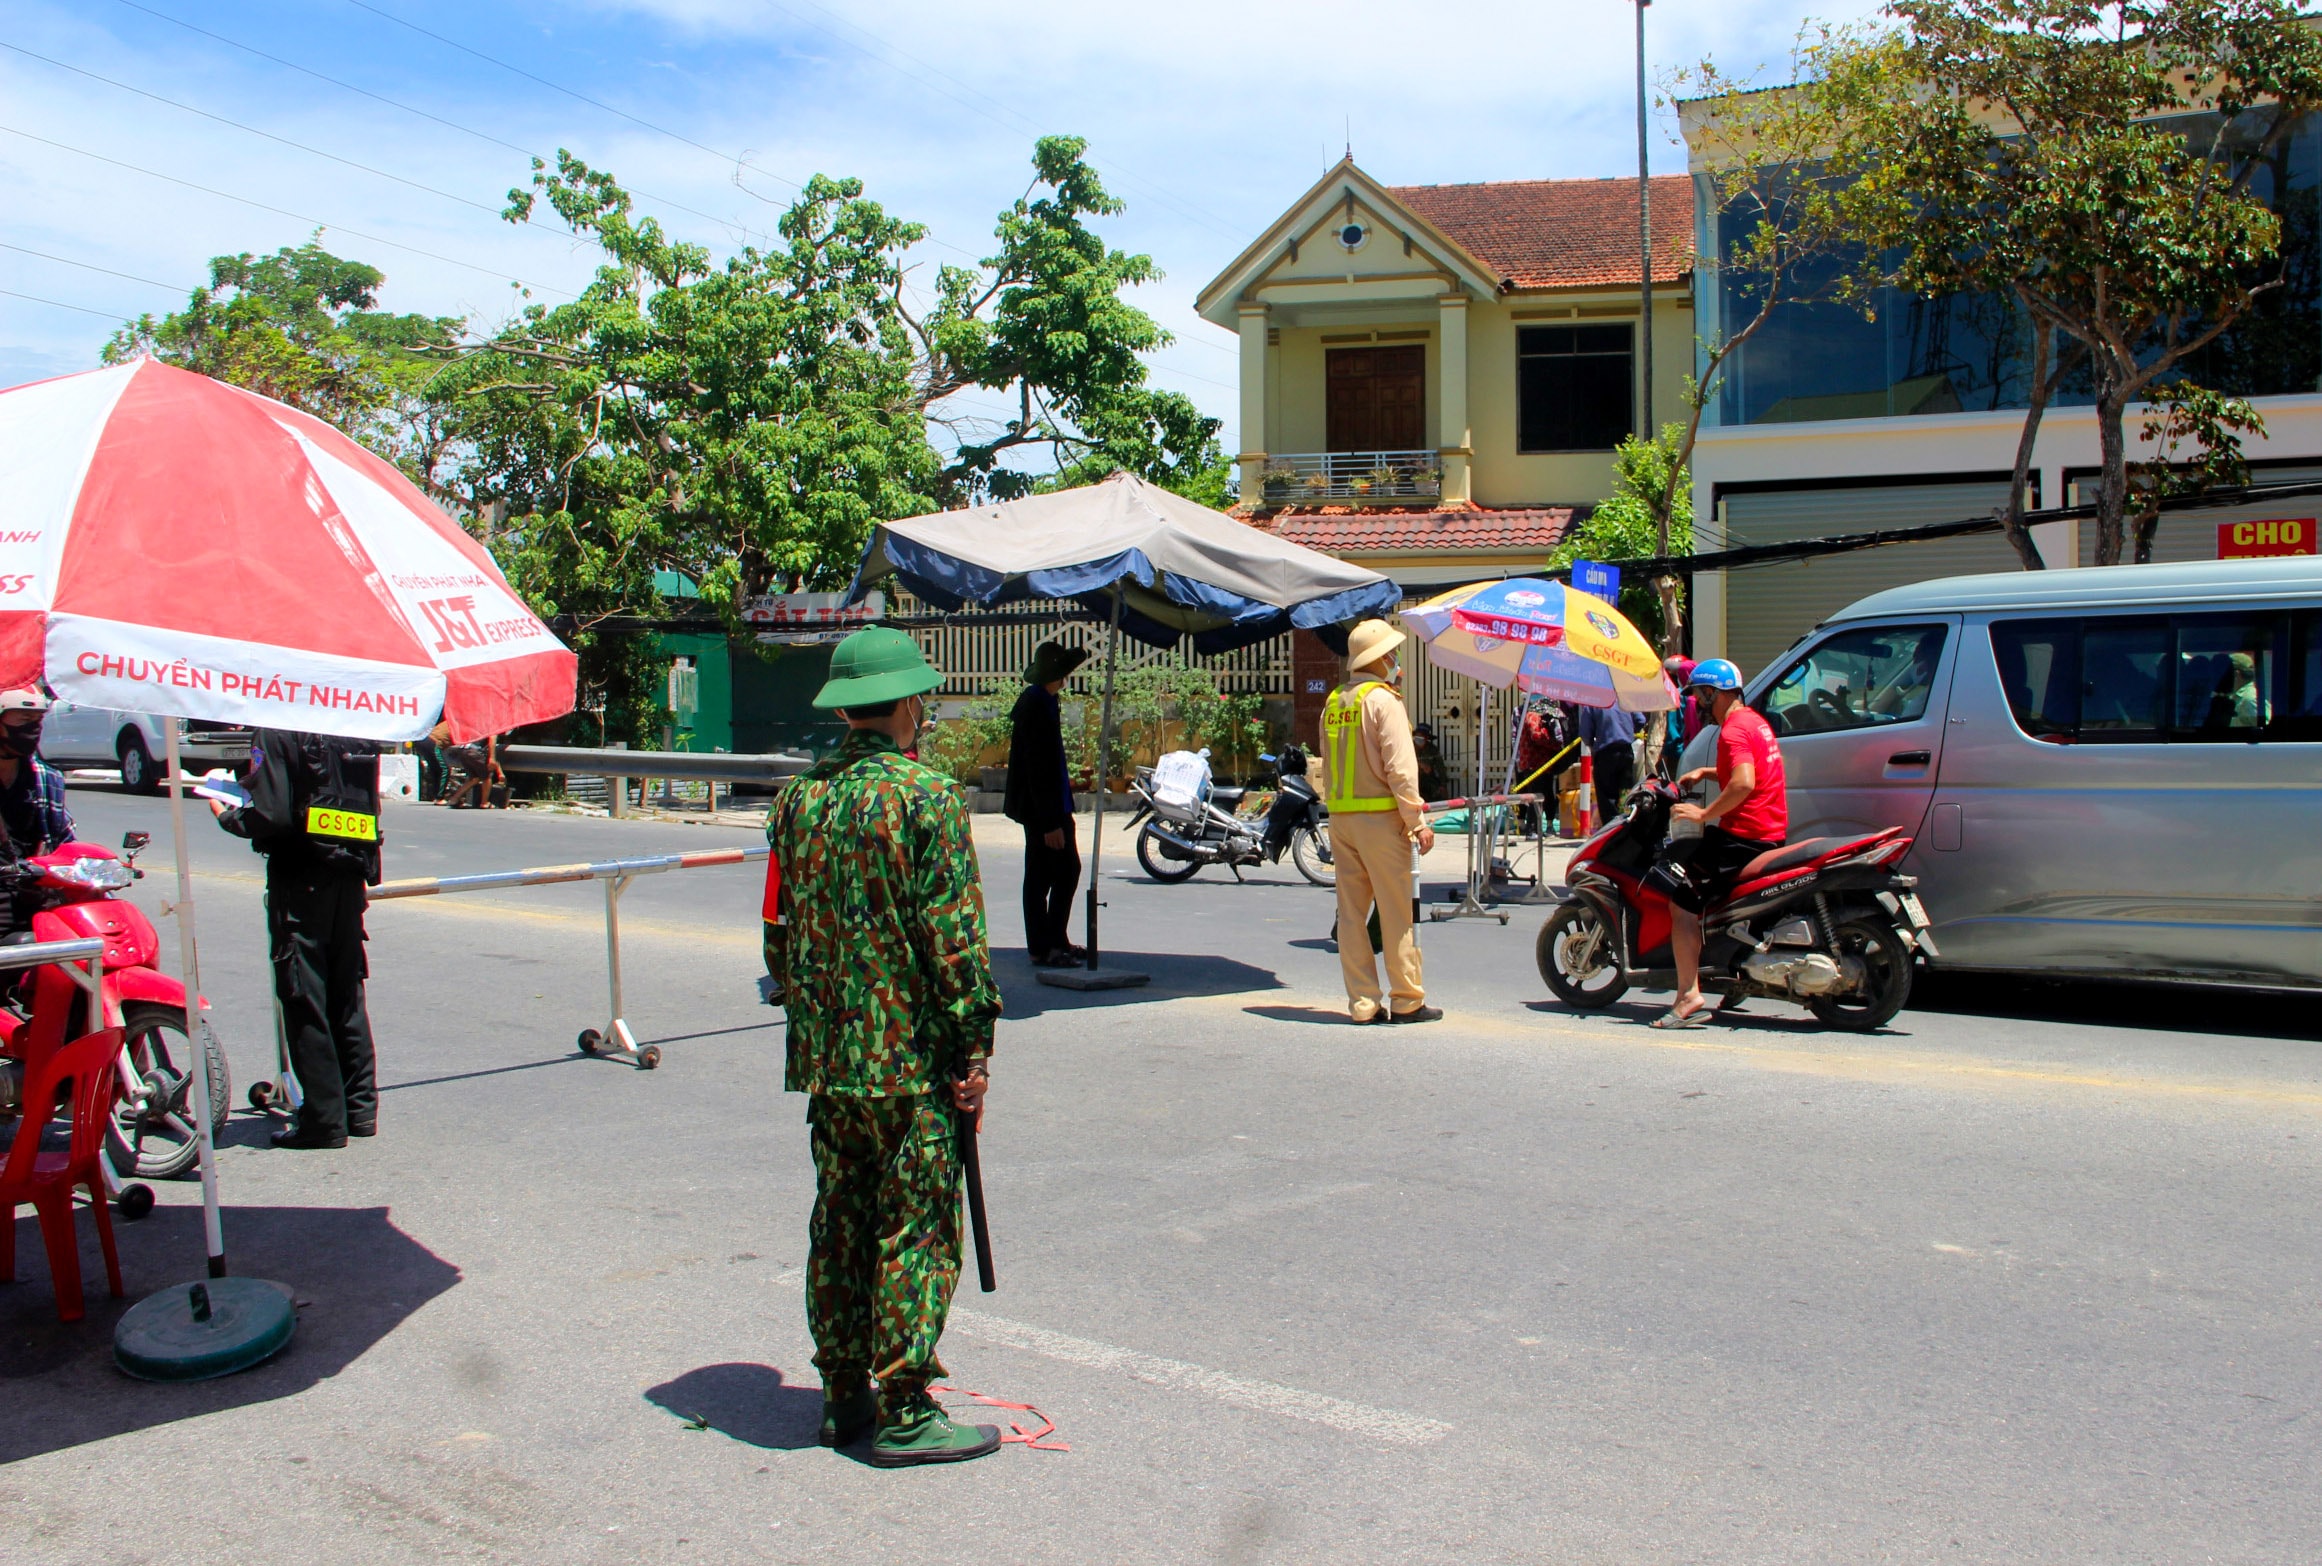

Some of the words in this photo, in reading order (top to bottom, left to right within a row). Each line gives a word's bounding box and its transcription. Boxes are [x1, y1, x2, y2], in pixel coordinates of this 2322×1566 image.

[0, 530, 42, 543] NH
[2232, 520, 2302, 545] CHO
[417, 595, 489, 653] J&T
[484, 617, 542, 644] EXPRESS
[1511, 623, 1528, 639] 98
[1531, 626, 1548, 642] 98
[1592, 643, 1632, 667] CSGT
[76, 651, 212, 690] CHUYỂN
[221, 673, 303, 703] PHÁT
[309, 684, 419, 717] NHANH
[1308, 681, 1325, 691] 242
[1760, 885, 1780, 898] AIR
[1780, 870, 1819, 891] BLADE
